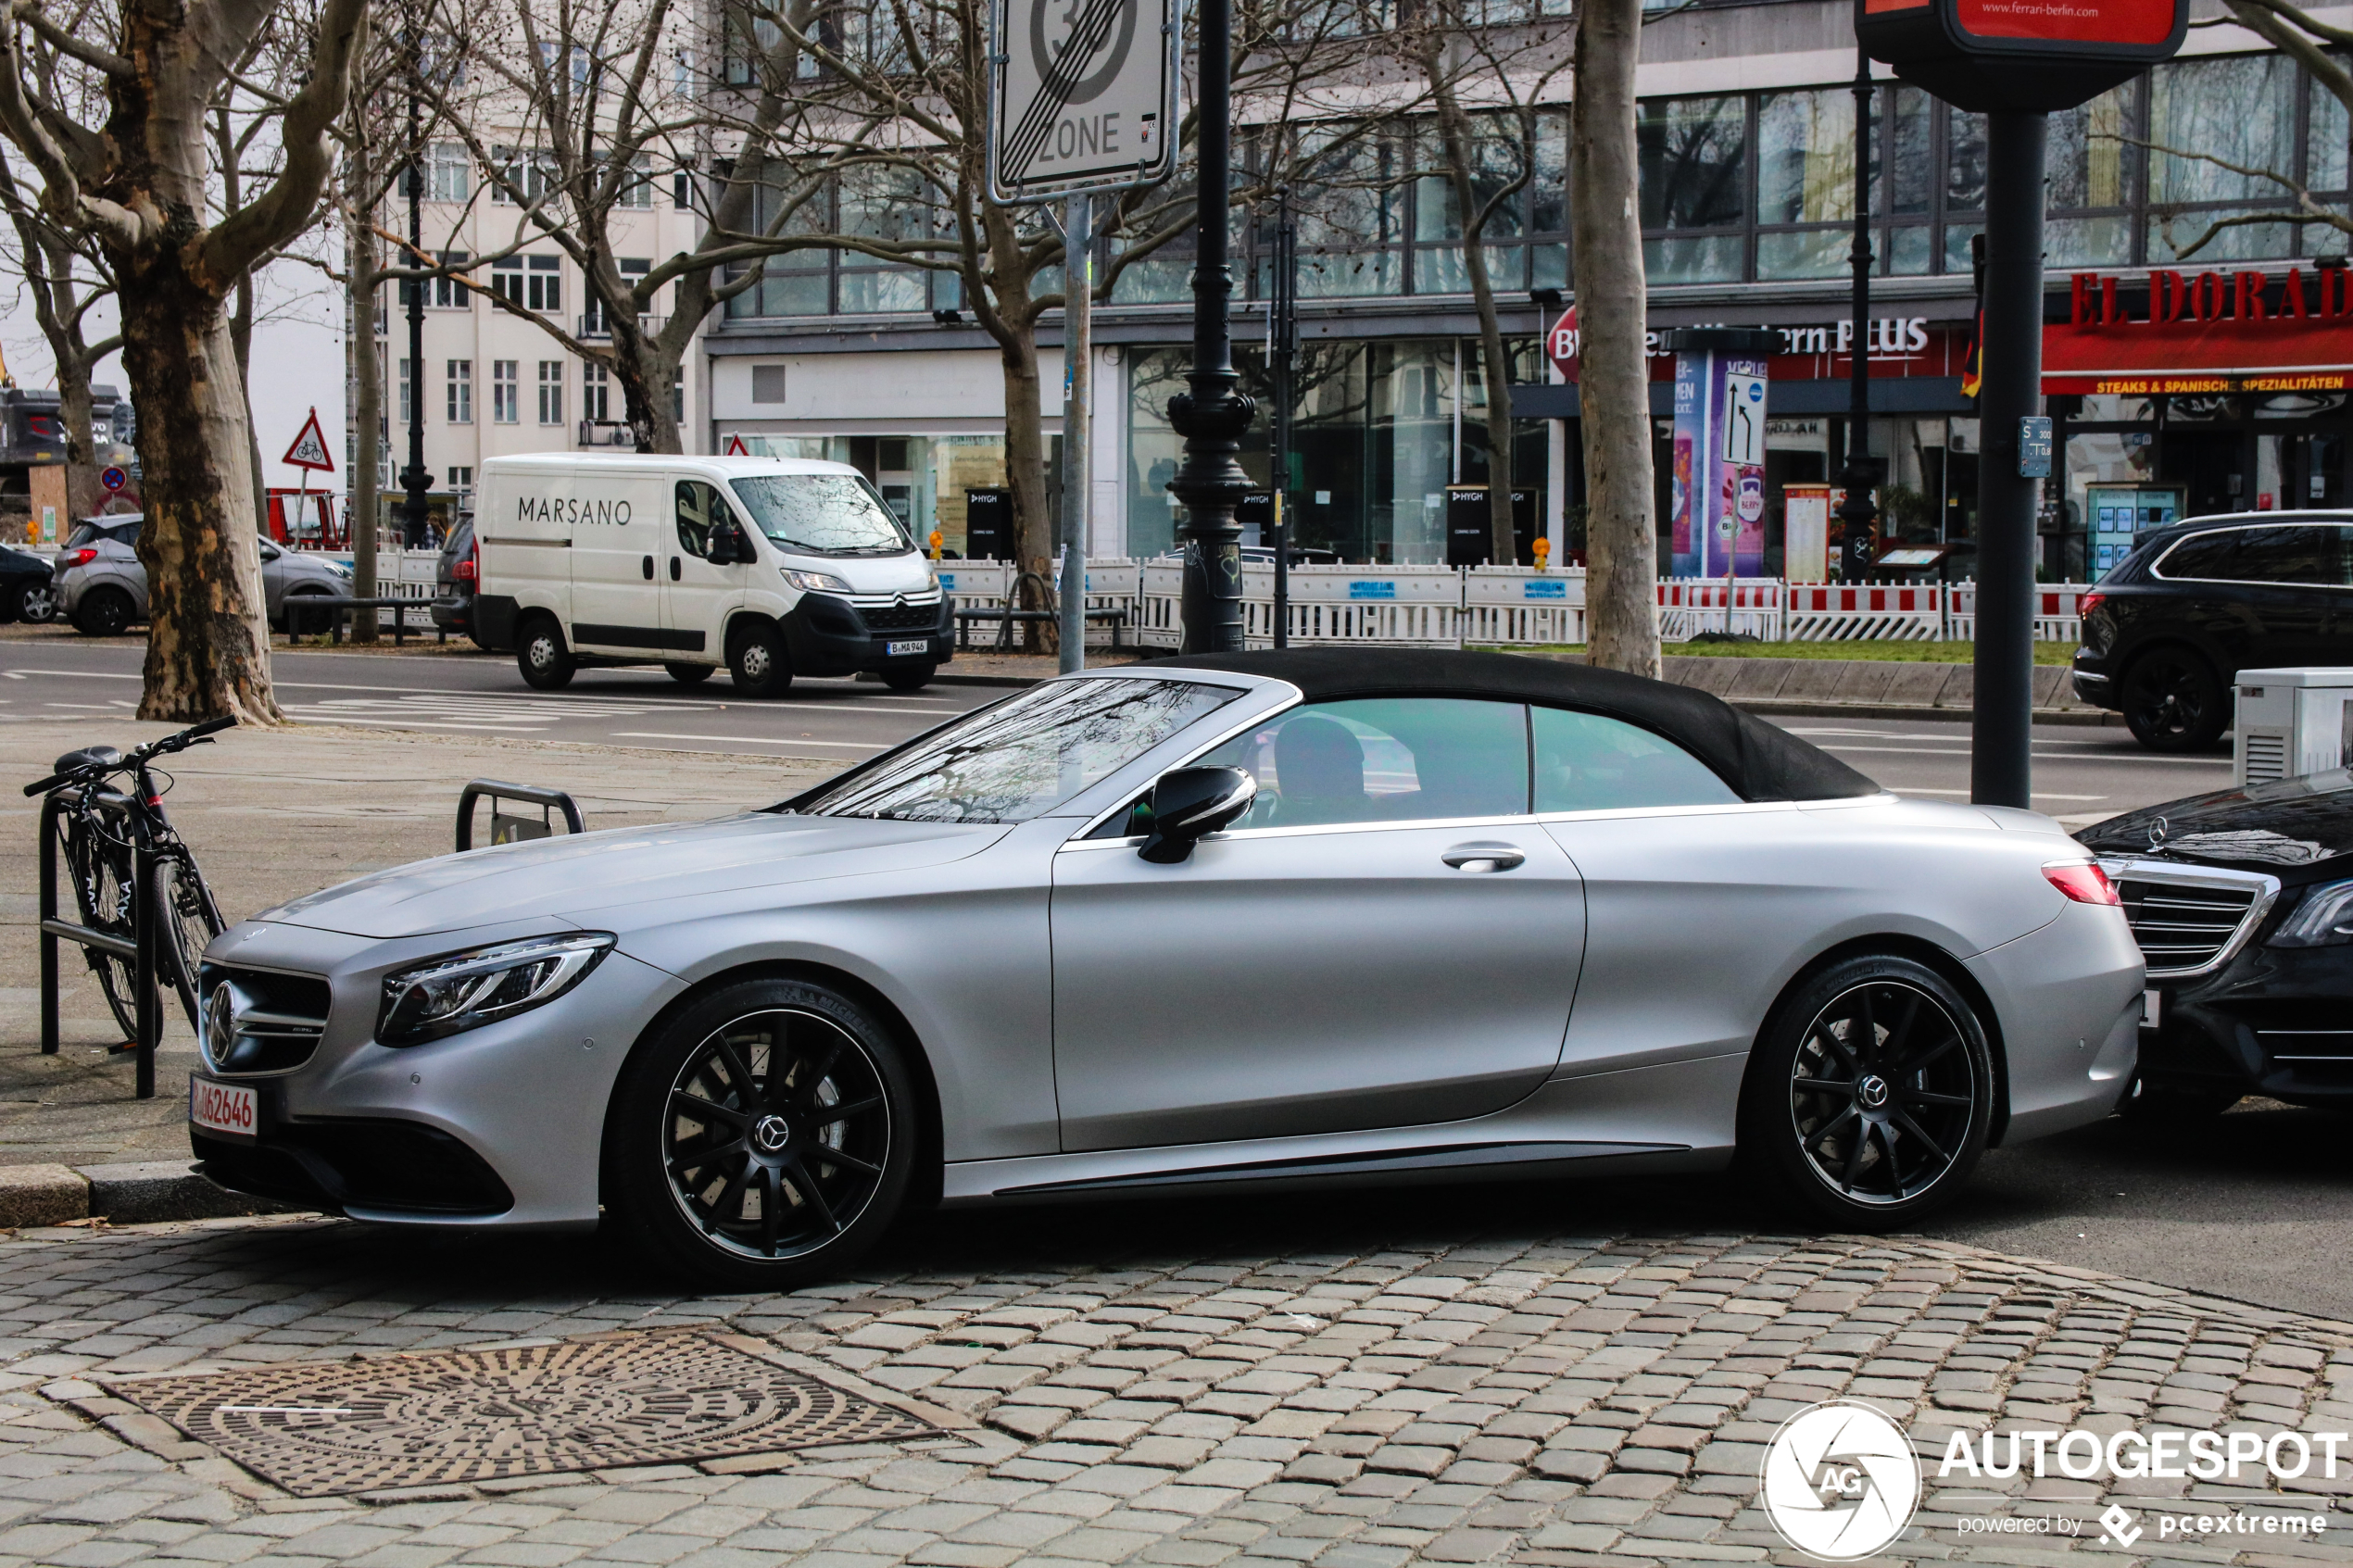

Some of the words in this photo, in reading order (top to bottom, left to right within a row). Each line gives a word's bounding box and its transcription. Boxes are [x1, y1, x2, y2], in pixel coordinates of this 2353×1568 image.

[1982, 2, 2099, 17] www.ferrari-berlin.com
[1038, 112, 1120, 162] ZONE
[2070, 272, 2129, 325] EL
[2146, 268, 2353, 323] DORAD
[2096, 382, 2147, 394] STEAKS
[2150, 382, 2160, 393] &
[2164, 380, 2237, 393] SPANISCHE
[2242, 375, 2344, 392] SPEZIALITÄTEN
[2023, 426, 2032, 439] S
[2039, 431, 2051, 439] 300
[977, 495, 997, 503] HYGH
[1251, 495, 1269, 504] HYGH
[1460, 492, 1483, 501] HYGH
[1511, 493, 1524, 501] YGH
[518, 496, 632, 526] MARSANO
[892, 643, 898, 653] B
[911, 642, 925, 651] 946
[116, 880, 132, 919] AXA
